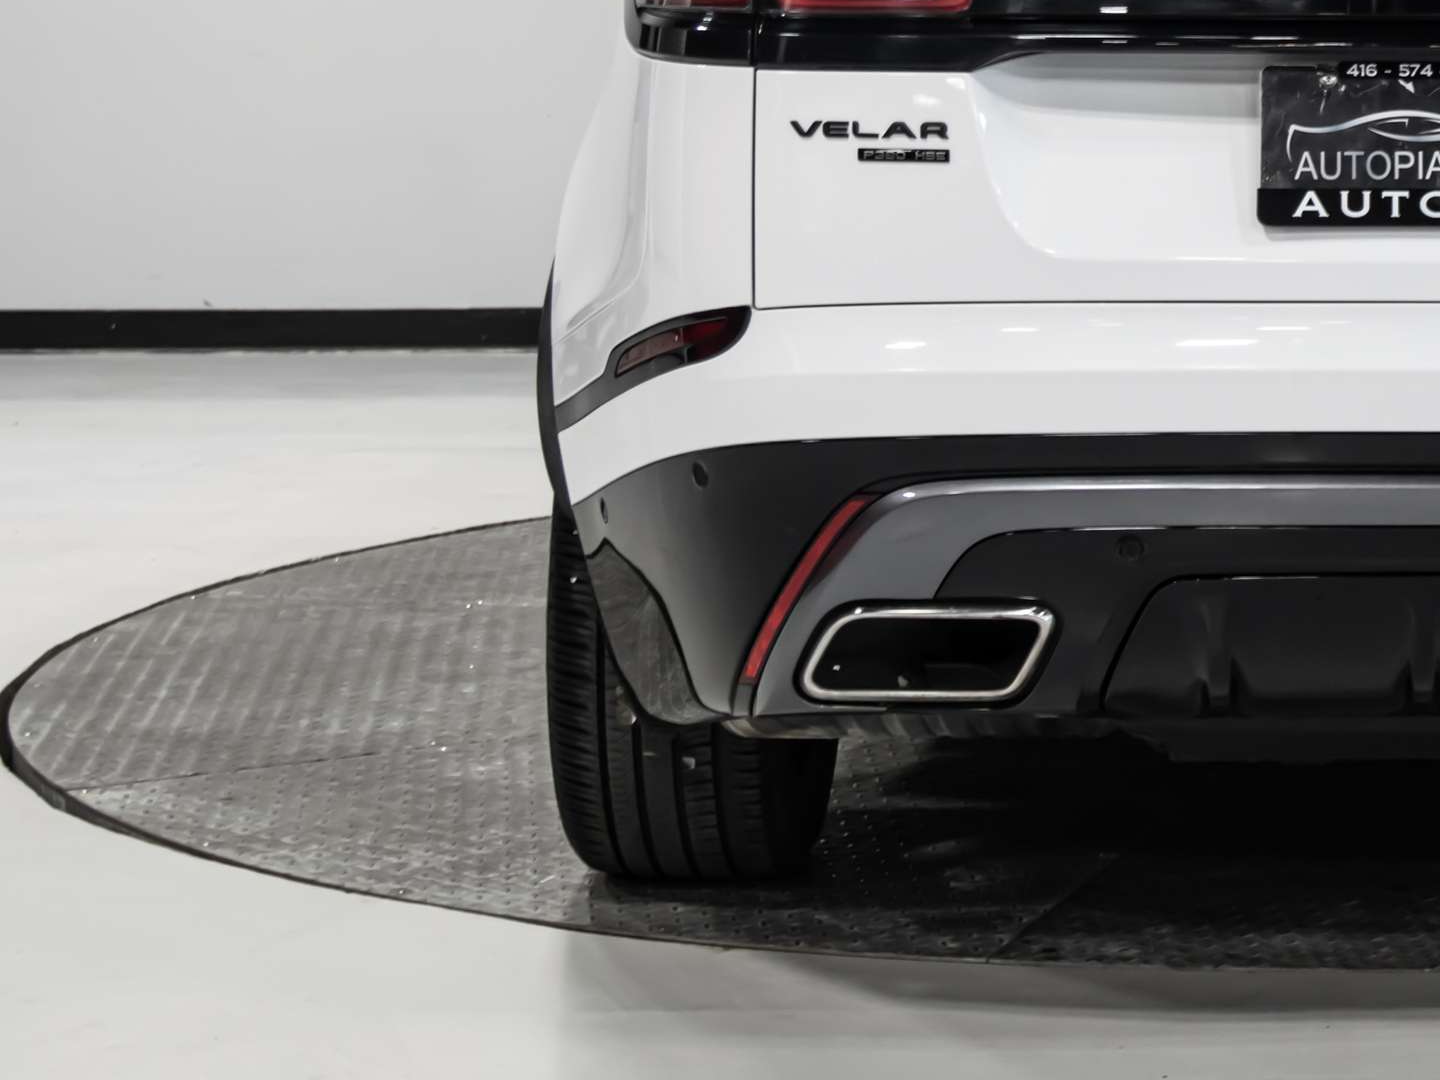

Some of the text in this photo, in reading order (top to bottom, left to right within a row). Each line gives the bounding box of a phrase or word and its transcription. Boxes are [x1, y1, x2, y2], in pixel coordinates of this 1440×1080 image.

[1347, 63, 1377, 77] 416
[1399, 63, 1433, 78] 574
[790, 120, 949, 140] VELAR
